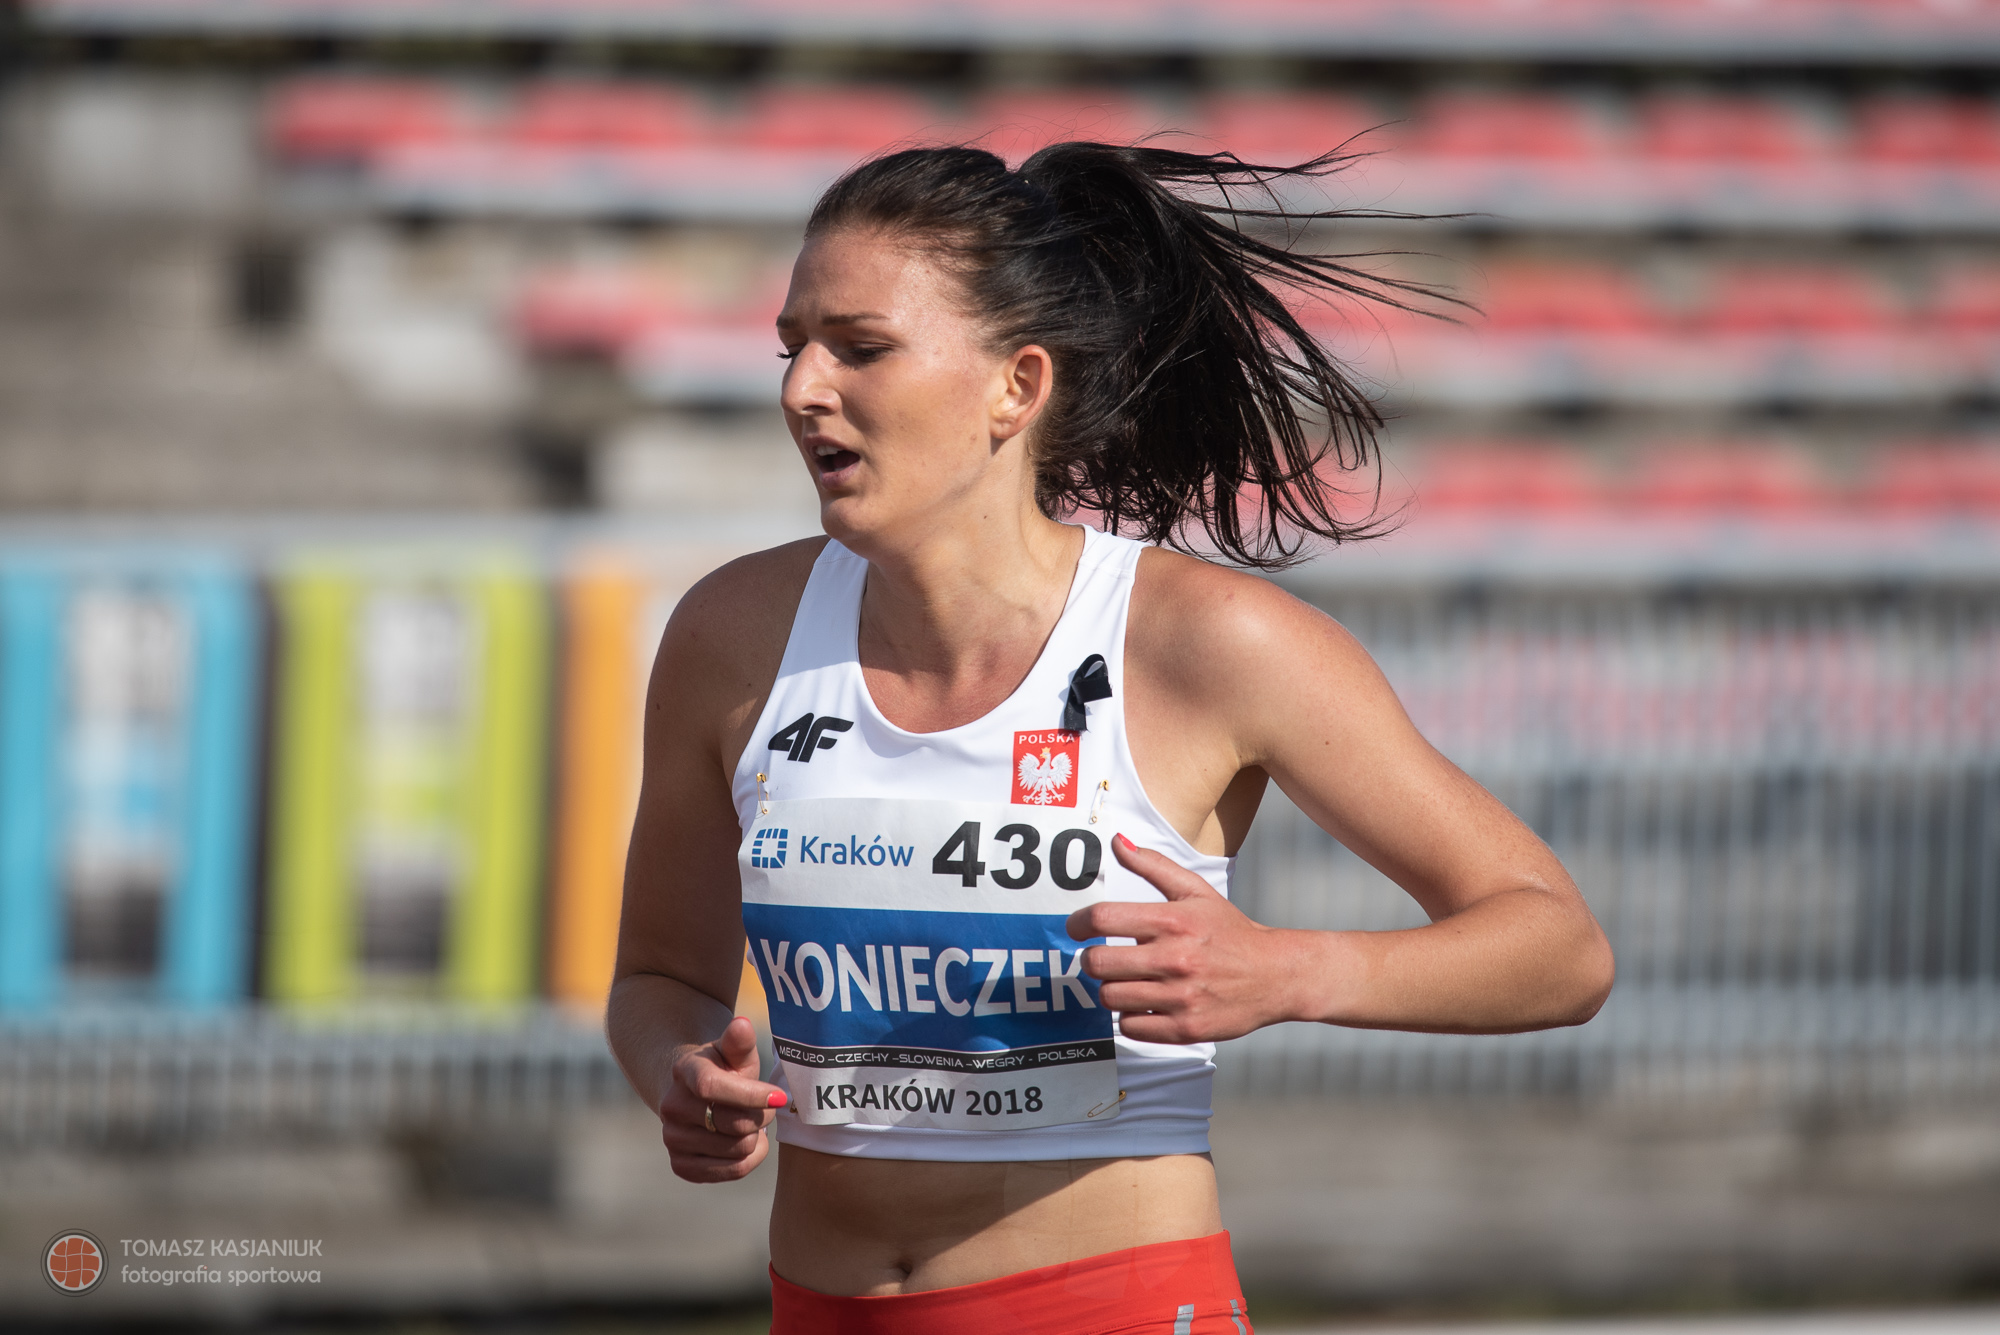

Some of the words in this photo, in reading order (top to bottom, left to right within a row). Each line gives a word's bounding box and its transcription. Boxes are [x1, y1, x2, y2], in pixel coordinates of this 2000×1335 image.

[768, 712, 854, 763] 4F
[1018, 733, 1075, 744] POLSKA
[799, 834, 915, 867] Kraków
[932, 821, 1102, 891] 430
[760, 938, 1097, 1017] KONIECZEK
[779, 1045, 801, 1060] MECZ
[802, 1053, 825, 1063] U20
[1038, 1047, 1097, 1062] POLSKA
[815, 1079, 956, 1114] KRAKÓW
[965, 1086, 1044, 1115] 2018
